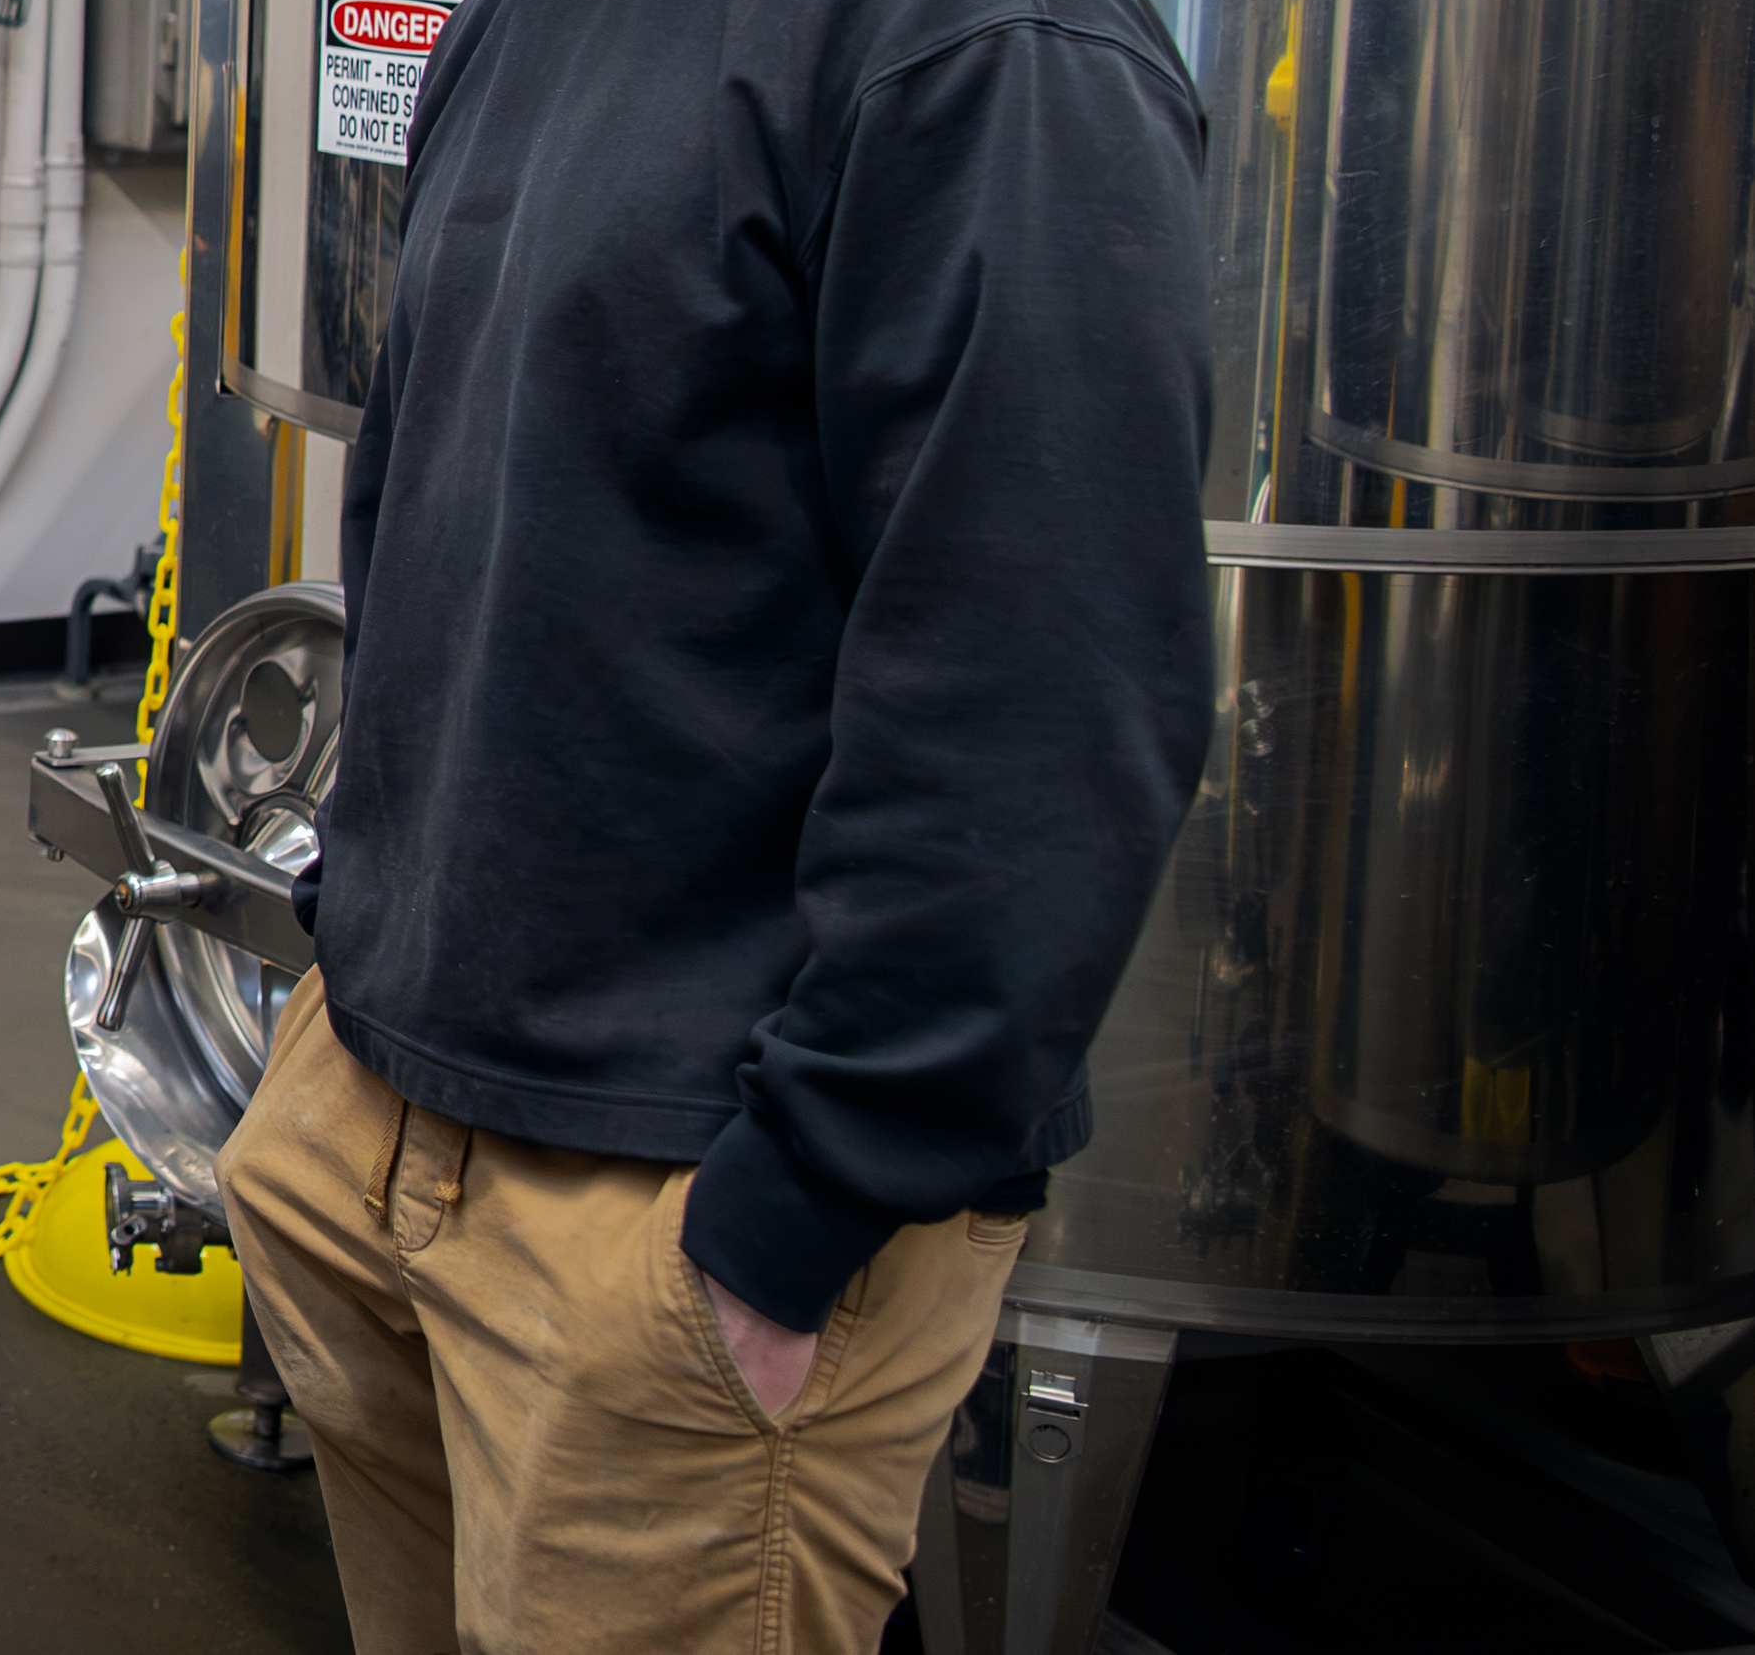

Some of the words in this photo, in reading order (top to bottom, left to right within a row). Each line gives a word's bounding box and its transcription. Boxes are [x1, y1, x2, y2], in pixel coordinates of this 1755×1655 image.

[343, 5, 446, 45] DANGER
[326, 54, 371, 83] PERMIT
[332, 84, 399, 115] CONFINED
[339, 114, 357, 139] DO
[360, 118, 389, 143] NOT
